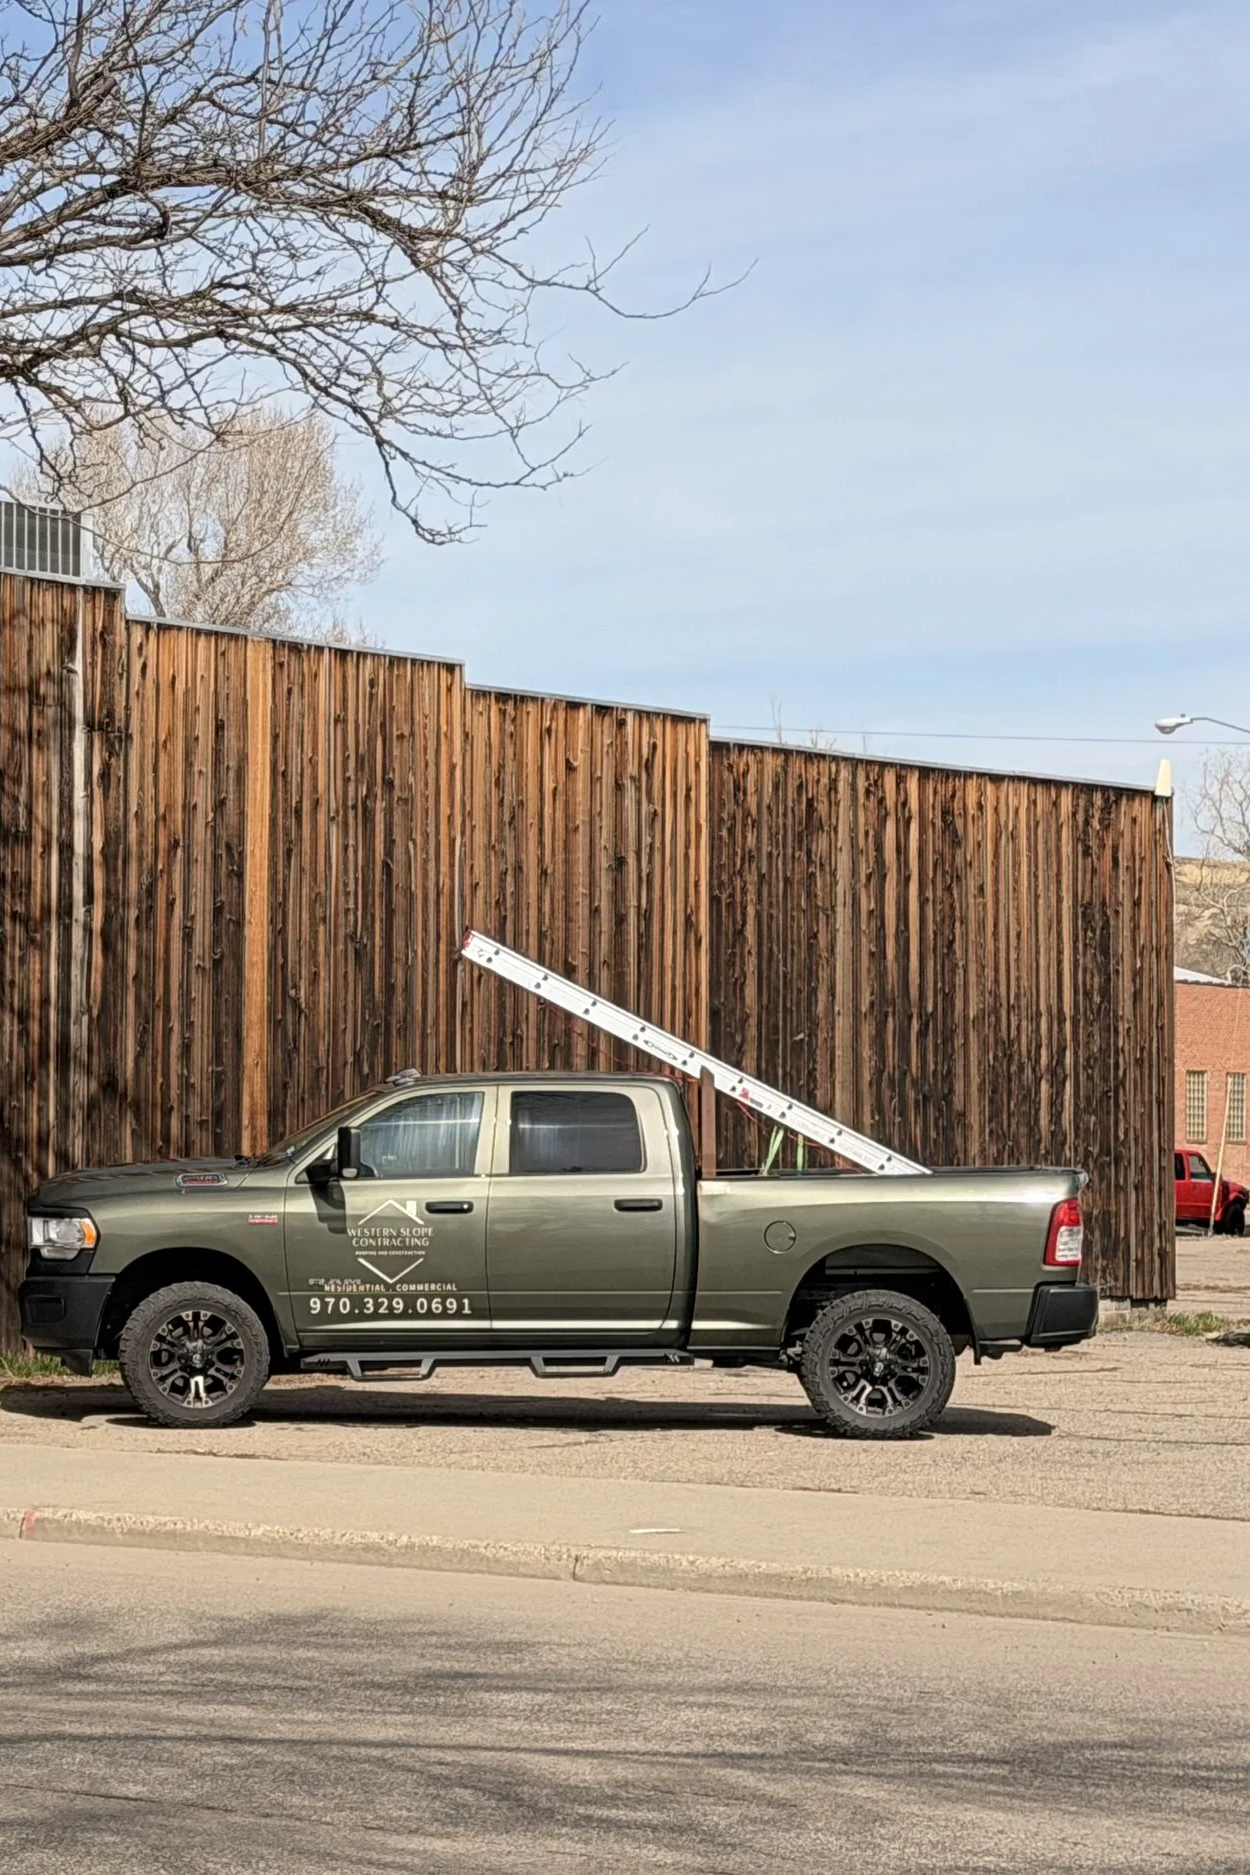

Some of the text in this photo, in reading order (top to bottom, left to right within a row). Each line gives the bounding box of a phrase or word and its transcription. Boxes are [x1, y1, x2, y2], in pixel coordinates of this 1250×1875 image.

[347, 1227, 434, 1238] WESTERN SLOPE
[352, 1237, 430, 1247] CONTRACTING
[324, 1283, 458, 1293] RESIDENTIAL COMMERCIAL
[309, 1297, 472, 1314] 970.329.0691
